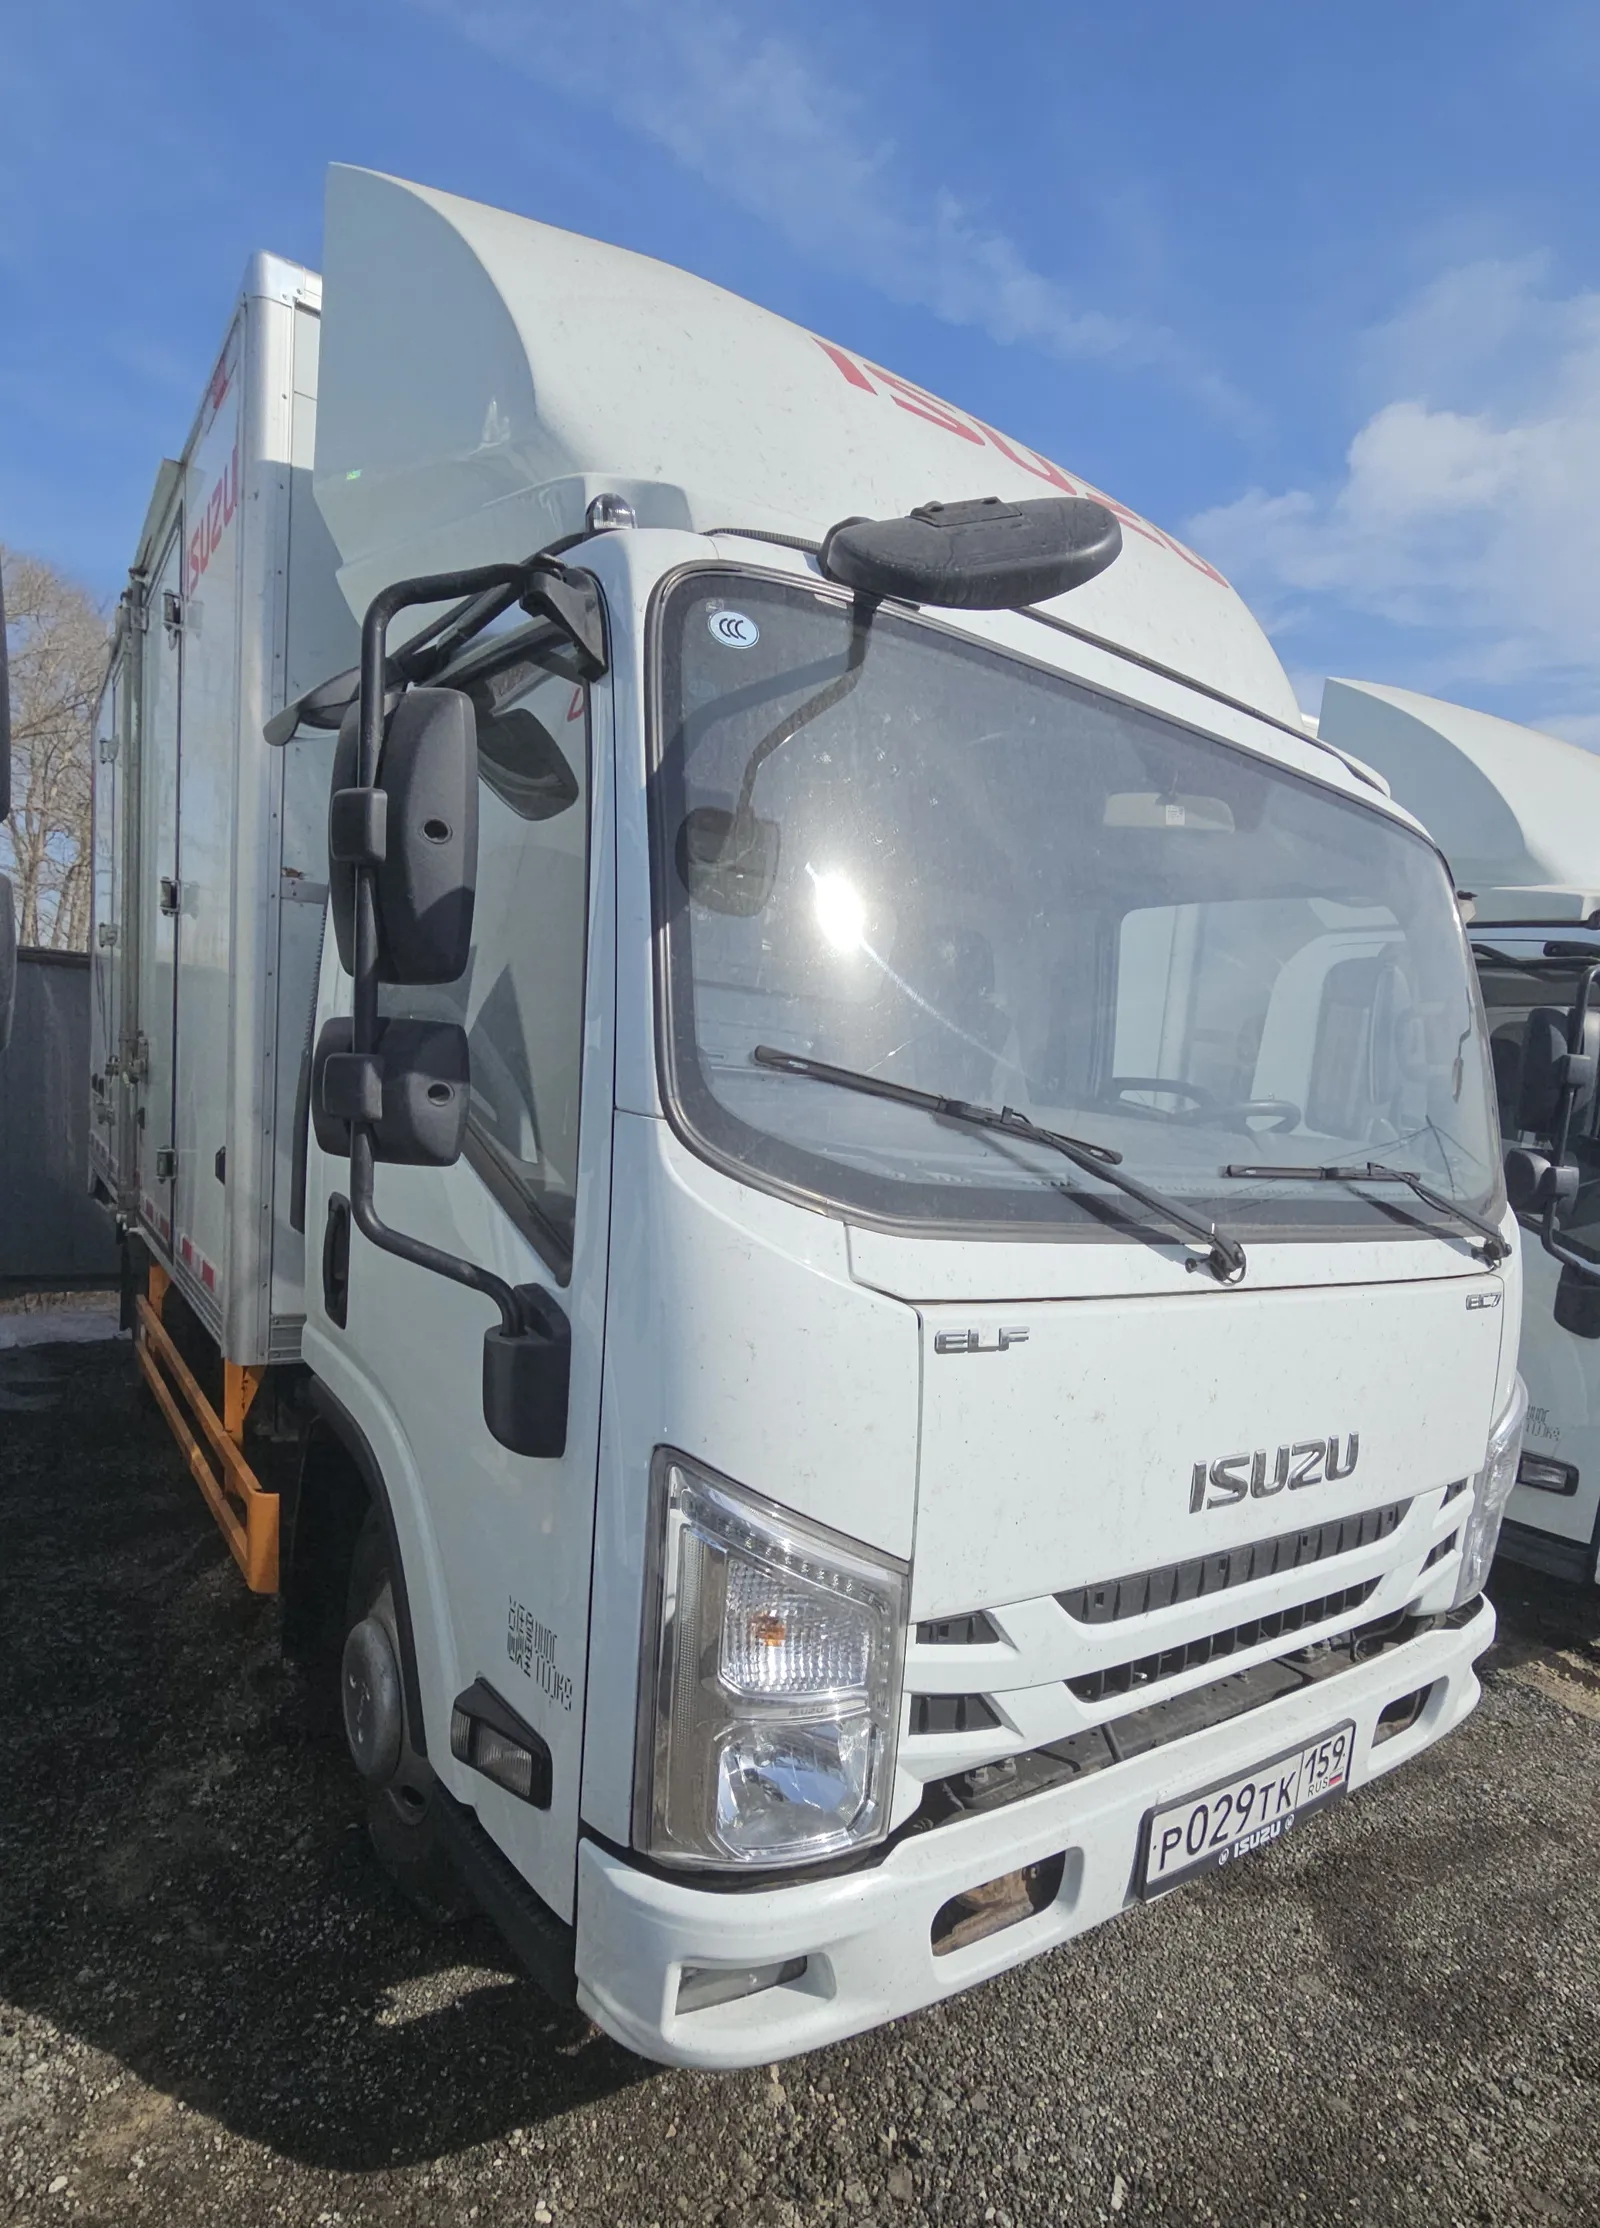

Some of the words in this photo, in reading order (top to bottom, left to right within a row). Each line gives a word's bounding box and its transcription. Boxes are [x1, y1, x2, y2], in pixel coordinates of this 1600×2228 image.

[1466, 1292, 1501, 1310] EC7
[935, 1326, 1030, 1354] ELF
[1189, 1431, 1359, 1514] ISUZU
[1304, 1735, 1346, 1784] 159
[1307, 1777, 1329, 1797] RUS
[1233, 1820, 1281, 1858] ISUZU
